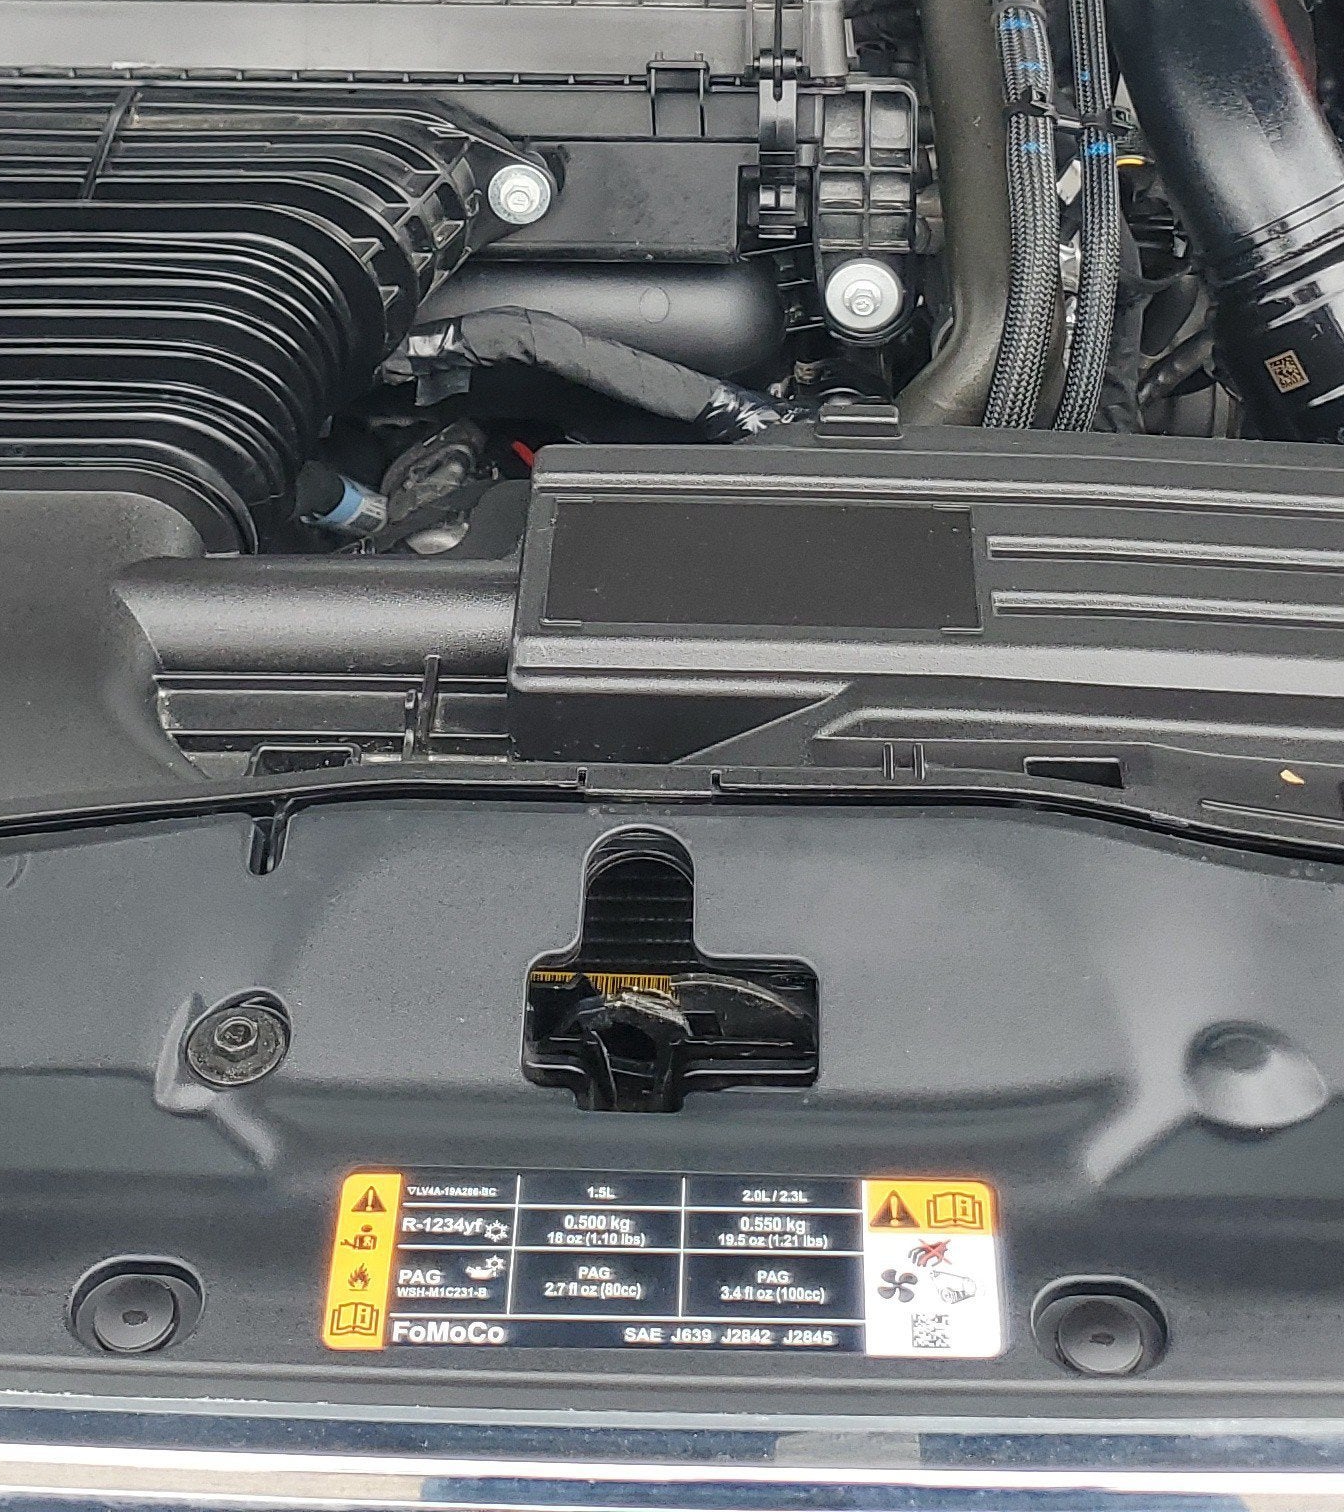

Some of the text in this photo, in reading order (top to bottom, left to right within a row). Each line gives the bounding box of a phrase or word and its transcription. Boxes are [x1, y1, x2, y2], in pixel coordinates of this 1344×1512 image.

[586, 1186, 616, 1199] 1.5L
[741, 1189, 771, 1203] 2.0L
[778, 1190, 808, 1203] 2.3L
[401, 1216, 484, 1236] R-1234yf
[563, 1214, 631, 1232] 0.500 kg
[739, 1216, 806, 1234] 0.550 kg
[565, 1234, 584, 1245] oz
[585, 1231, 618, 1247] (1.10
[620, 1232, 645, 1247] lbs)
[718, 1233, 828, 1249] 19.5 oz (1.21 lbs)
[398, 1268, 443, 1285] PAG
[578, 1266, 612, 1280] PAG
[756, 1269, 790, 1283] PAG
[543, 1281, 643, 1300] 2.7 fl oz (80cc)
[719, 1285, 827, 1305] 3.4 fl oz (100cc)
[392, 1320, 506, 1345] FoMoCo
[623, 1327, 836, 1346] SAE J639 J2842 J2845
